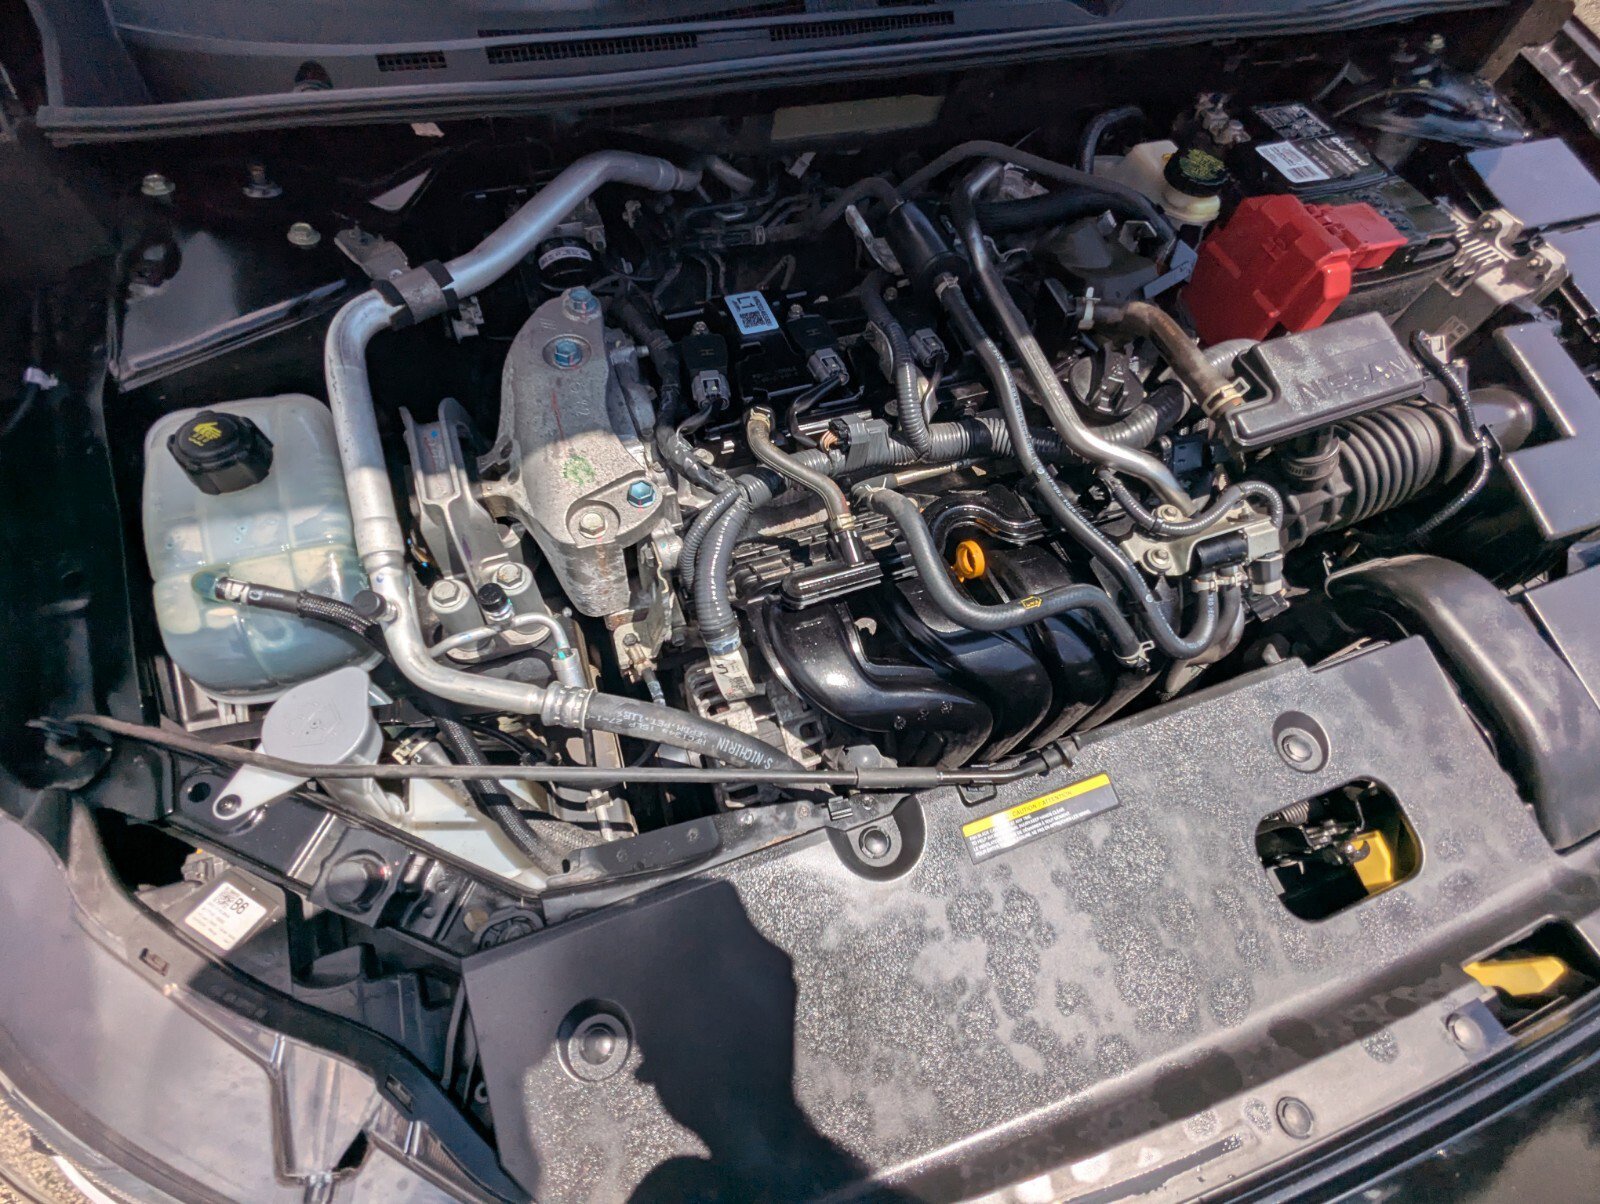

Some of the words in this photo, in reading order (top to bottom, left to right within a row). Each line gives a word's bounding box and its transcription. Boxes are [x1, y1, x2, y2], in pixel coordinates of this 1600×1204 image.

[1329, 136, 1370, 167] DieHard
[1296, 355, 1408, 406] NISSAN
[1012, 803, 1037, 816] CAUTION
[1042, 790, 1073, 805] ATTENTION
[229, 897, 250, 915] B6
